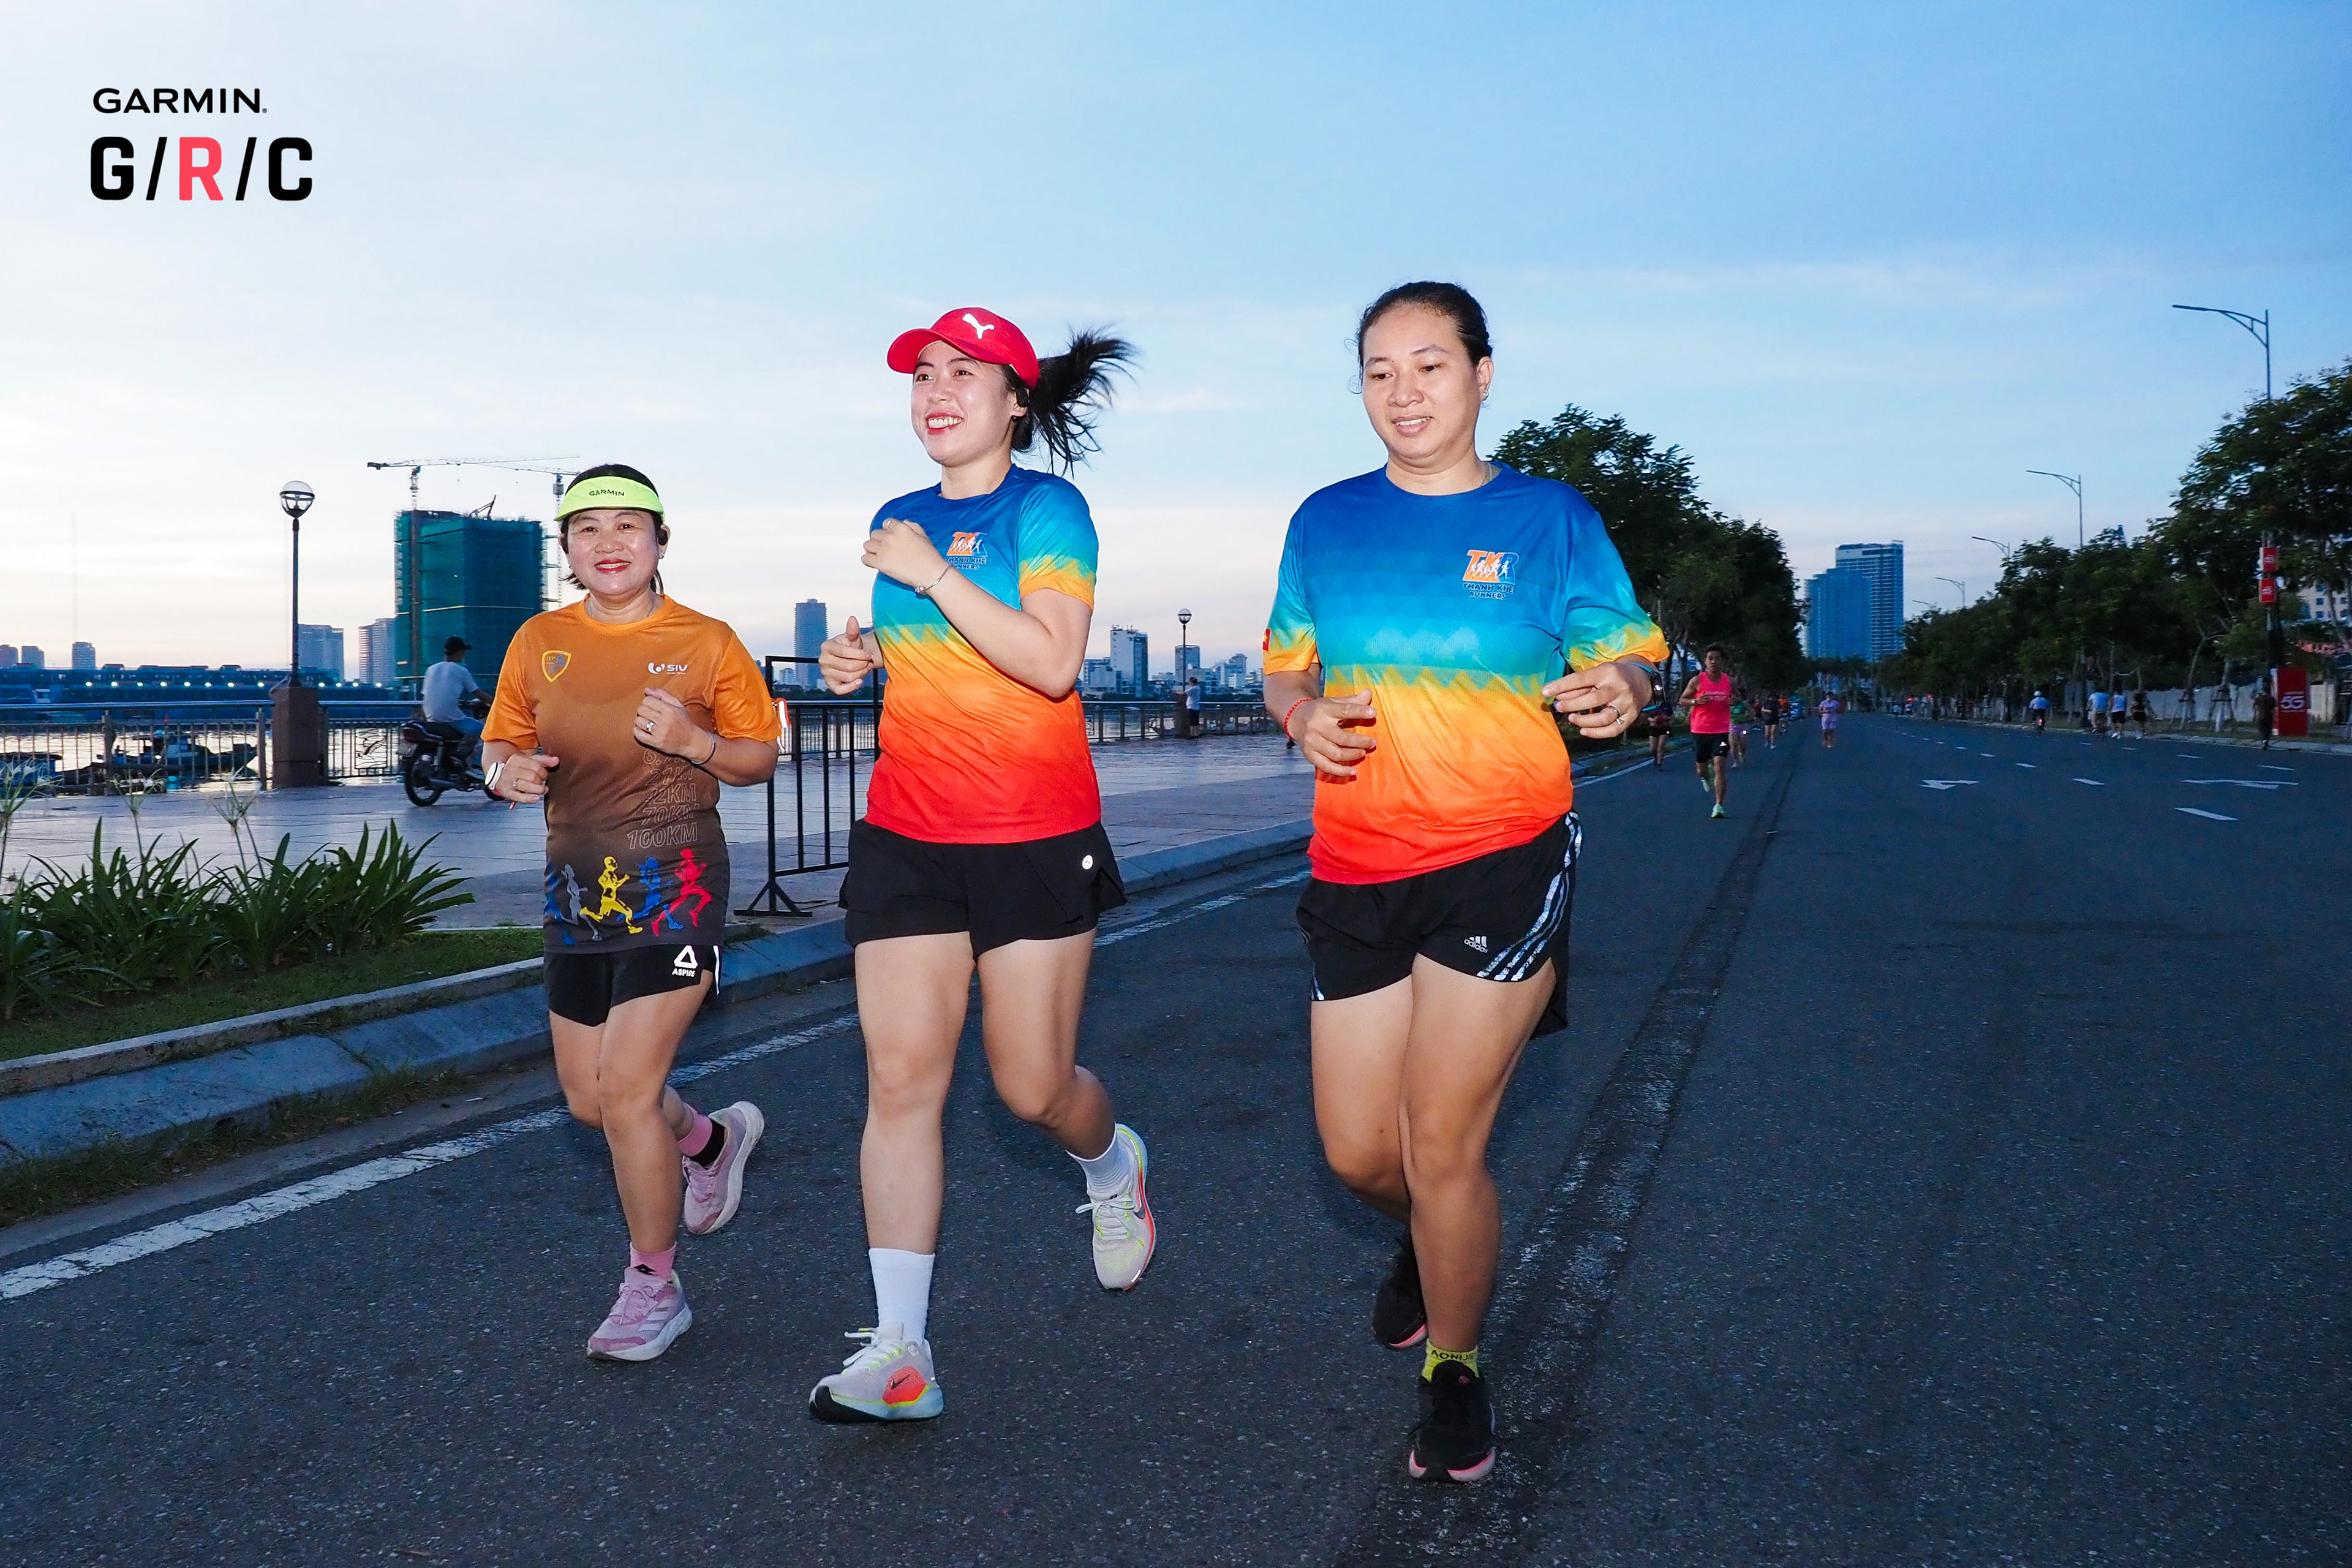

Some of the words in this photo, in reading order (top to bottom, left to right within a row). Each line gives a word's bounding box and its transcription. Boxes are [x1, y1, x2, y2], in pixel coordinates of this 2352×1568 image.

[1463, 582, 1494, 592] THANH
[1469, 590, 1506, 600] RUNNERS
[627, 822, 698, 850] 100KM
[1464, 938, 1488, 953] adidas
[672, 968, 696, 978] ASPIRE
